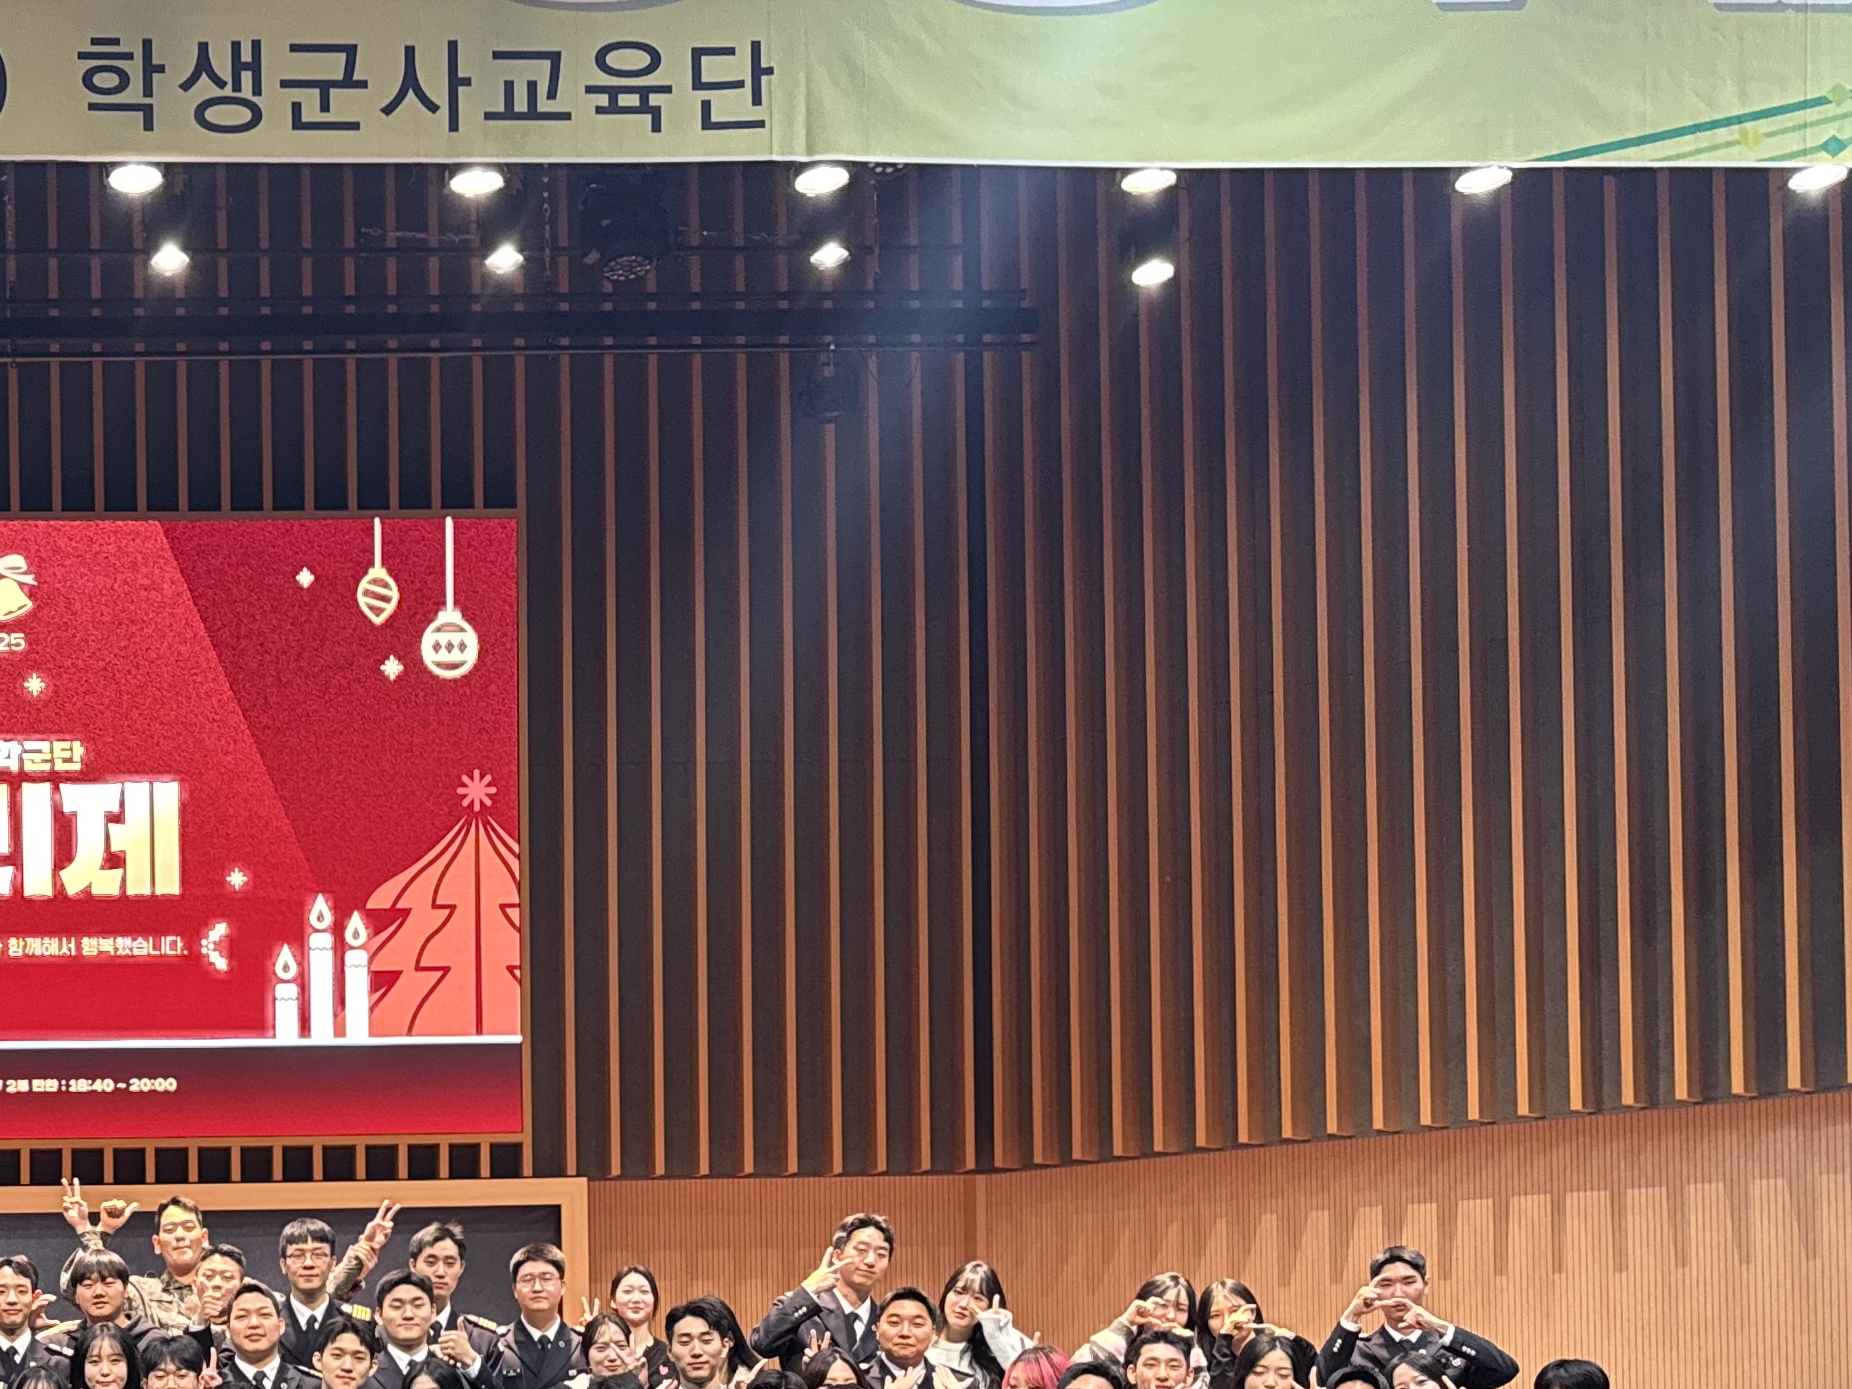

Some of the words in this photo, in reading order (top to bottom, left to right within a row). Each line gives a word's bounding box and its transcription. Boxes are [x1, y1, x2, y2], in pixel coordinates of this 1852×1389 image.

[76, 36, 775, 133] 학생군사교육단
[7, 937, 78, 958] 함께해서
[80, 936, 189, 958] 행복했습니다.
[68, 1079, 116, 1093] 18:40
[128, 1078, 178, 1093] 20:00
